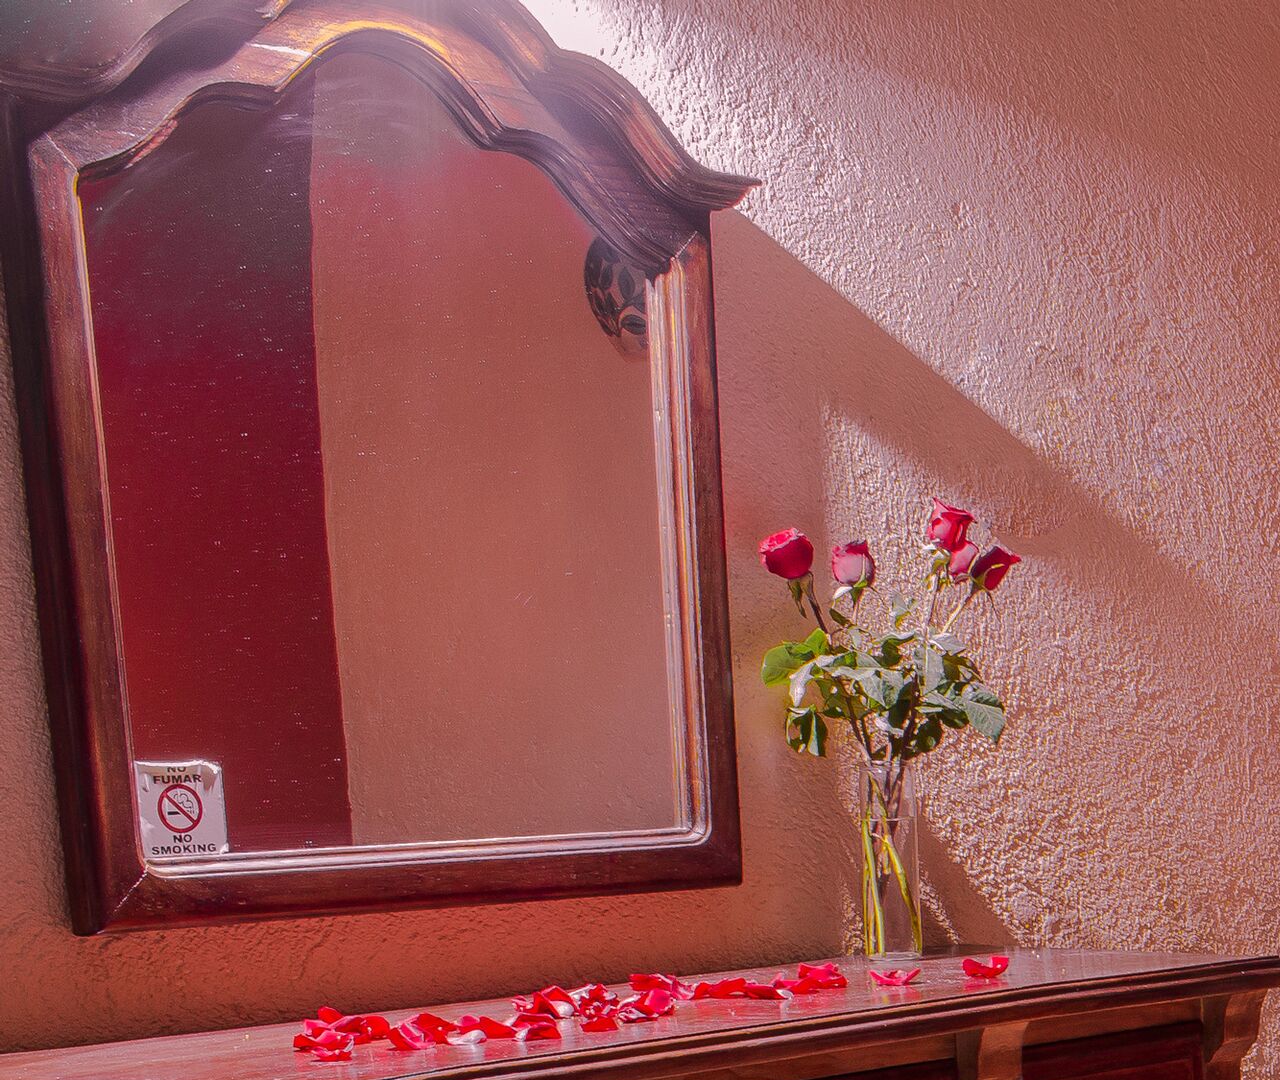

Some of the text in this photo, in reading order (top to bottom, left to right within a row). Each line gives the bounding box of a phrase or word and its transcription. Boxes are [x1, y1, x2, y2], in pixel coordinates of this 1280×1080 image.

[153, 774, 202, 785] FUMAR
[173, 834, 193, 843] NO
[152, 843, 217, 855] SMOKING
